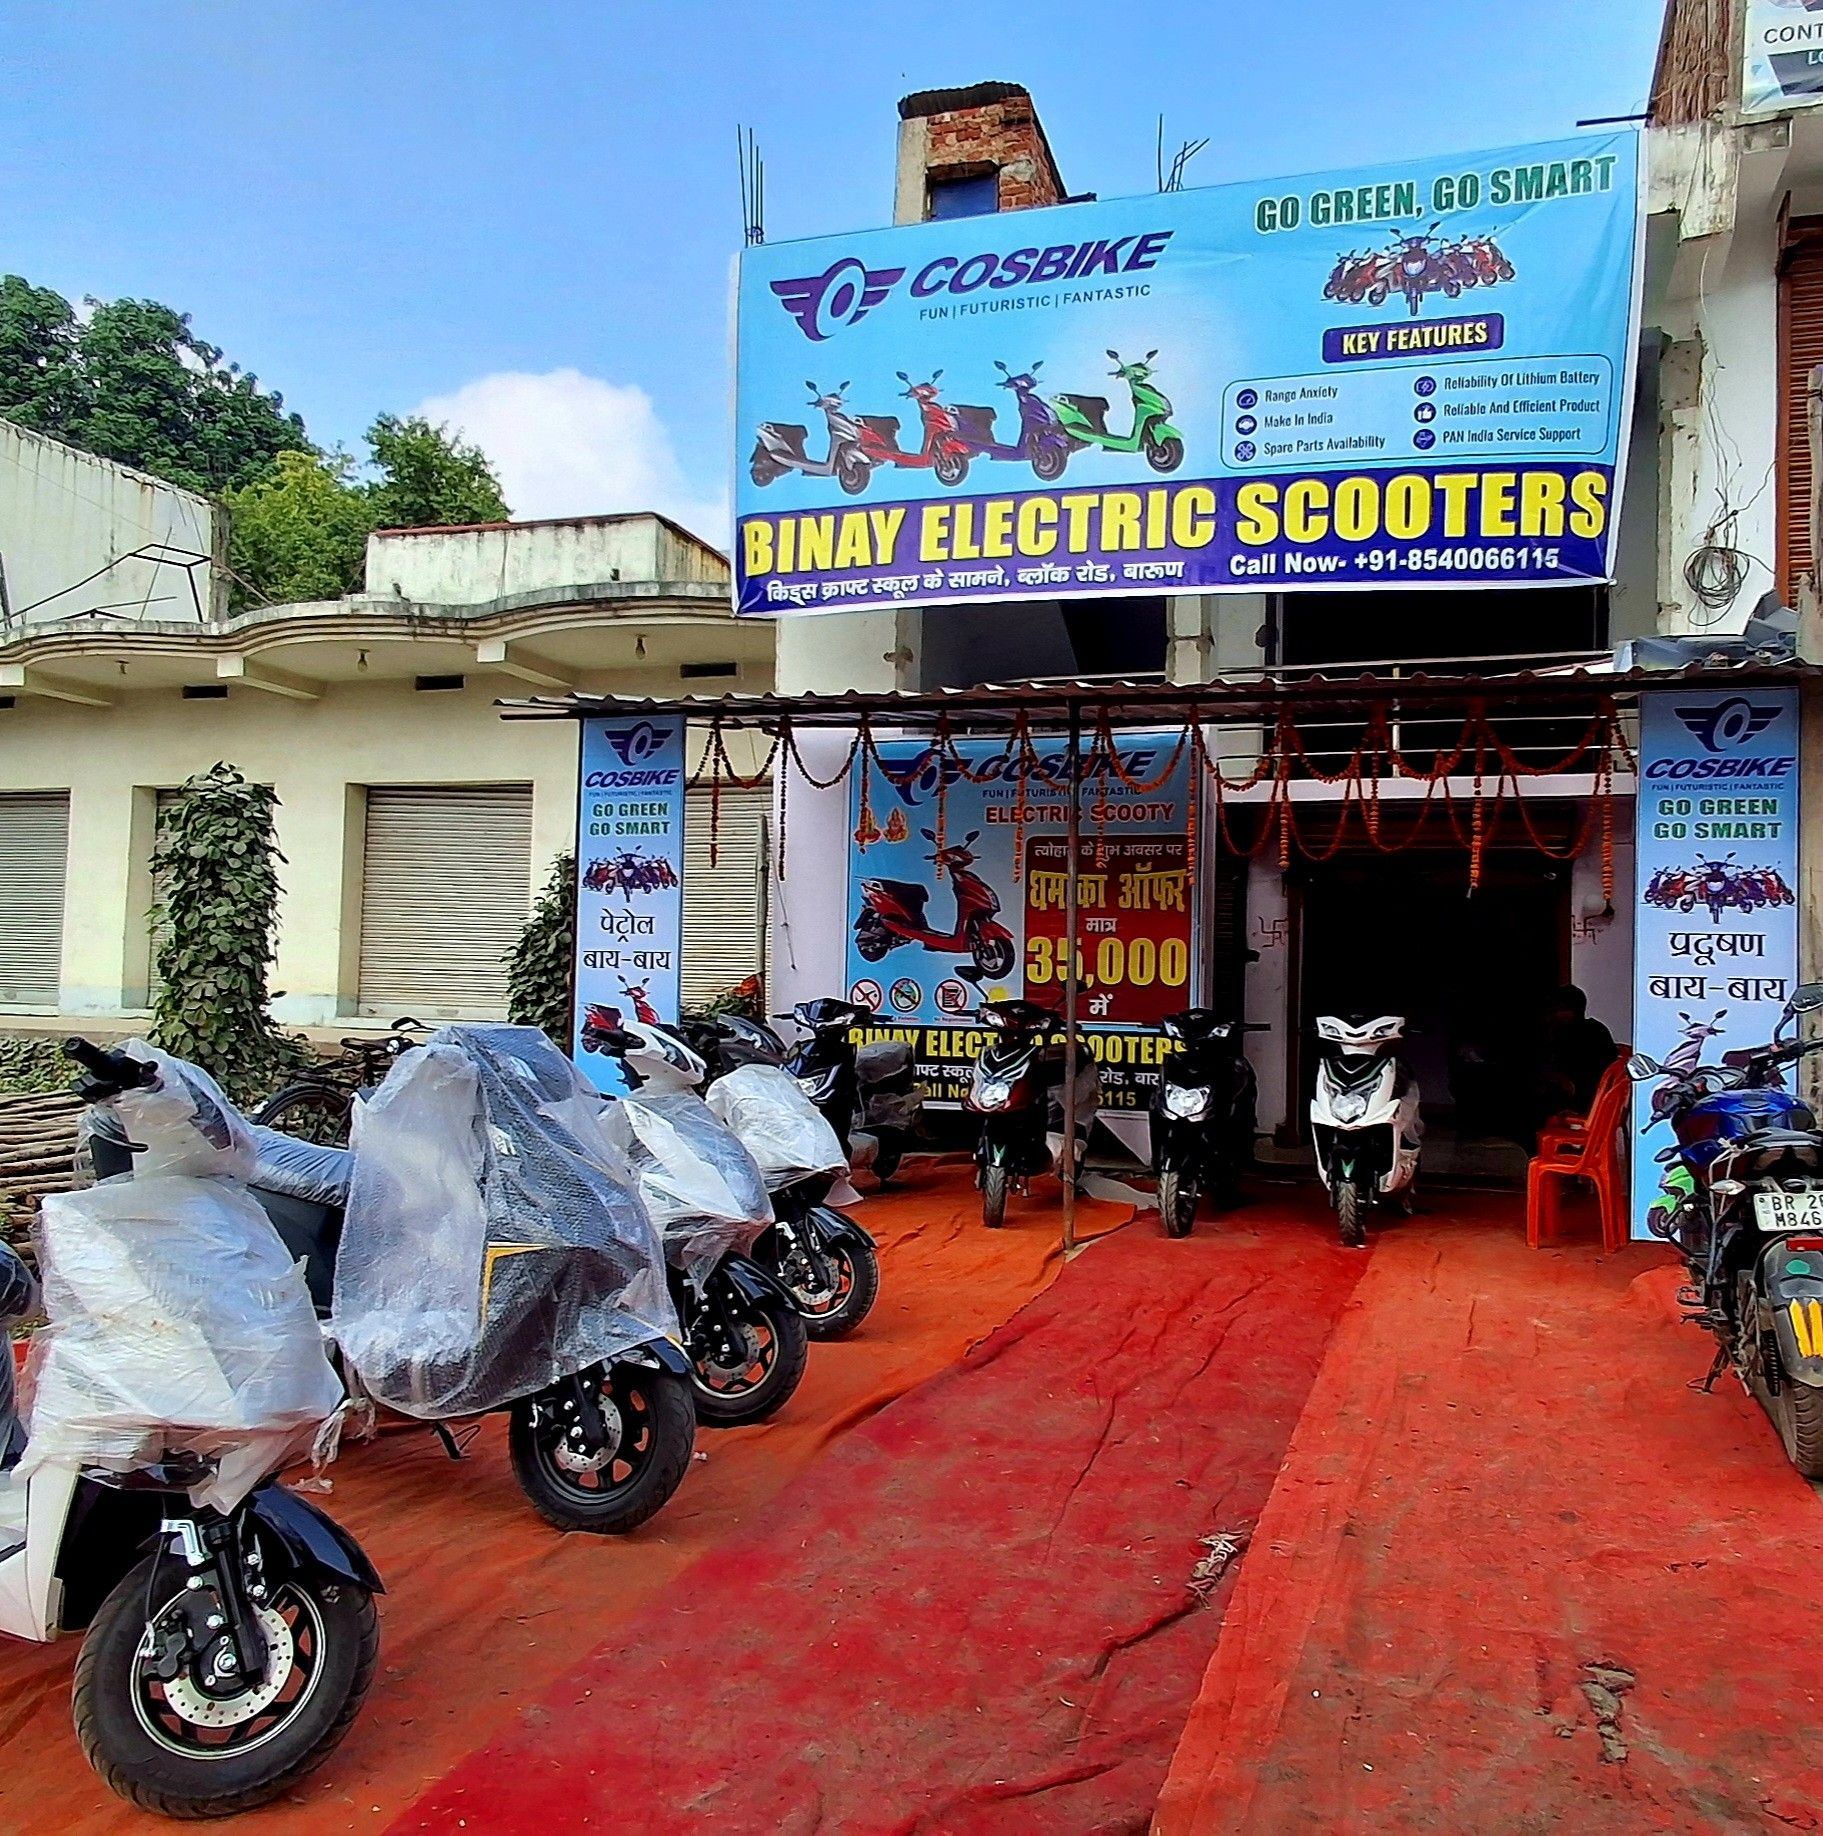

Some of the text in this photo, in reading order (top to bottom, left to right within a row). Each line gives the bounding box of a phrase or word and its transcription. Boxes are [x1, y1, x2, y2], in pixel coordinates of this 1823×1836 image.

[1257, 156, 1616, 233] GO GREEN, GO SMART
[909, 230, 1175, 298] COSBIKE
[919, 284, 1151, 321] FUN FUTURISTIC FANTASTIC
[1342, 322, 1488, 355] KEY FEATURES
[1444, 370, 1600, 390] Reliability Of Lithium Battery
[1265, 385, 1339, 403] Range Anxiety
[1443, 398, 1600, 417] Reliable And Efficient Product
[1264, 411, 1334, 429] Make In India
[1443, 427, 1581, 444] PAN India Service Support
[1264, 435, 1386, 457] Spare Parts Availability
[742, 471, 1608, 578] BINAY ELECTRIC SCOOTERS
[1230, 547, 1559, 576] Call Now- +91-8540066115
[822, 578, 870, 600] क्राफ्ट
[871, 574, 921, 600] स्कूल
[923, 568, 945, 589] के
[1645, 756, 1796, 779] COSBIKE
[585, 769, 681, 788] COSBIKE
[592, 802, 668, 817] GO GREEN
[1090, 803, 1175, 823] SCOOTY
[1658, 798, 1778, 816] GO GREEN
[589, 821, 672, 836] GO SMART
[1654, 822, 1782, 839] GO SMART
[1034, 841, 1072, 858] त्योहा
[1080, 841, 1094, 857] के
[1166, 844, 1184, 856] पर
[600, 908, 656, 943] पेट्रोल
[1085, 917, 1118, 933] मात्र
[1668, 932, 1767, 966] प्रदूषण
[583, 950, 672, 970] बाय-बाय
[1026, 935, 1188, 989] 35,000
[1648, 975, 1789, 1002] बाय-बाय
[1088, 993, 1114, 1016] में
[1771, 1195, 1795, 1211] BR
